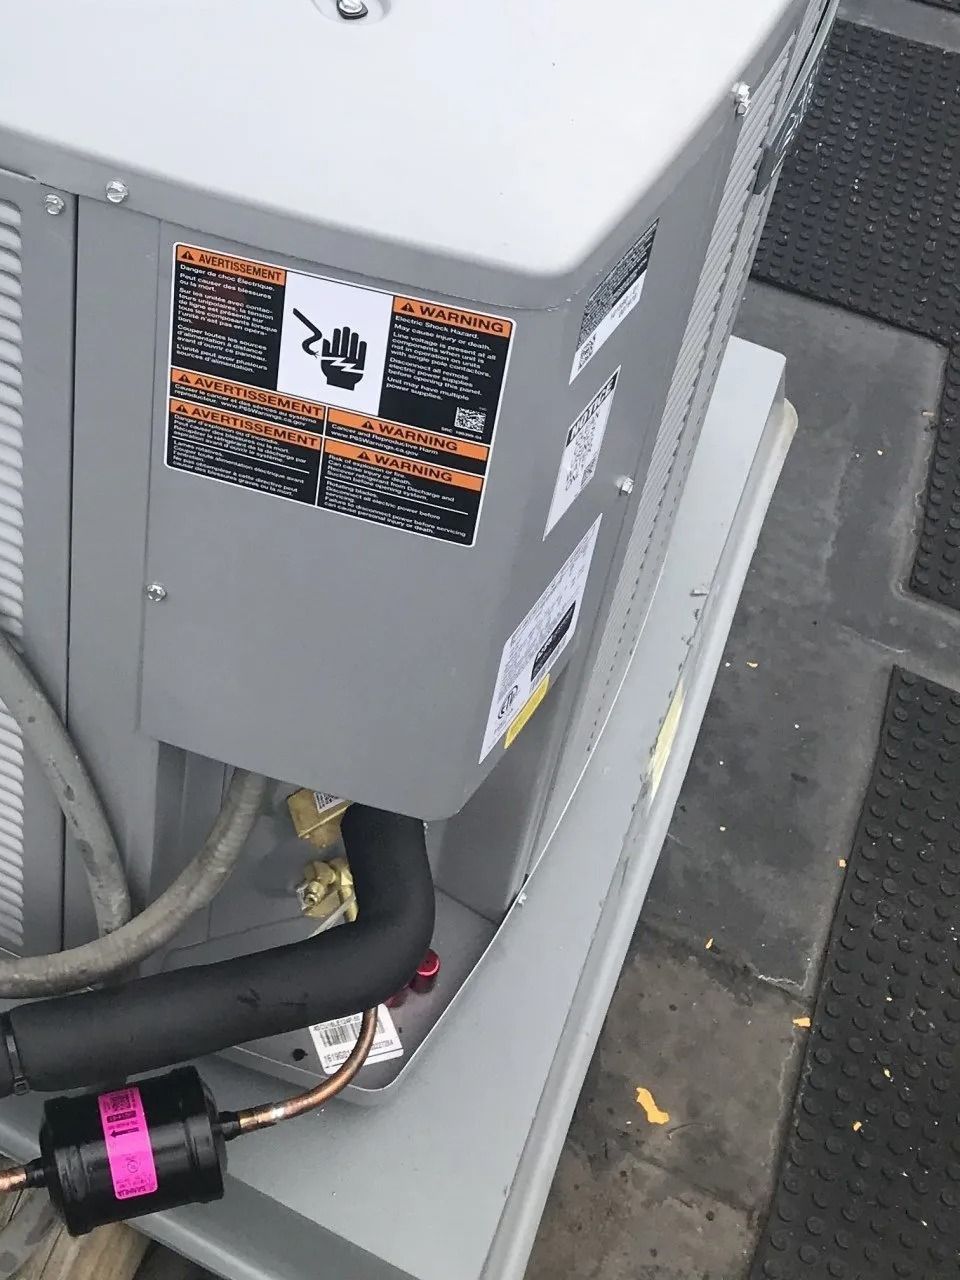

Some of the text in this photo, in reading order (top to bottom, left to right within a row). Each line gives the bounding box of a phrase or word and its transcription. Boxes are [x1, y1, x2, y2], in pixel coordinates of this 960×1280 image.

[198, 253, 281, 281] AVERTISSEMENT
[395, 315, 423, 326] Electric
[425, 322, 448, 332] Shock
[418, 304, 504, 333] WARNING
[393, 331, 409, 340] Line
[410, 337, 438, 346] voltage
[447, 345, 476, 356] present
[394, 323, 410, 332] May
[411, 328, 434, 337] cause
[435, 333, 457, 343] injury
[392, 338, 438, 353] components
[439, 349, 460, 358] when
[413, 349, 449, 361] operation
[462, 361, 481, 369] units
[389, 357, 431, 371] Disconnect
[442, 371, 469, 380] remote
[407, 354, 430, 363] single
[431, 359, 448, 367] pole
[386, 383, 409, 391] power
[388, 363, 473, 387] electric power supplies
[388, 368, 412, 378] before
[413, 375, 443, 387] opening
[444, 382, 458, 390] this
[194, 376, 321, 417] AVERTISSEMENT
[386, 376, 469, 400] Unit may have multiple
[569, 378, 614, 440] NOTICE
[191, 407, 317, 447] AVERTISSEMENT
[378, 423, 458, 451] WARNING
[374, 454, 453, 482] WARNING
